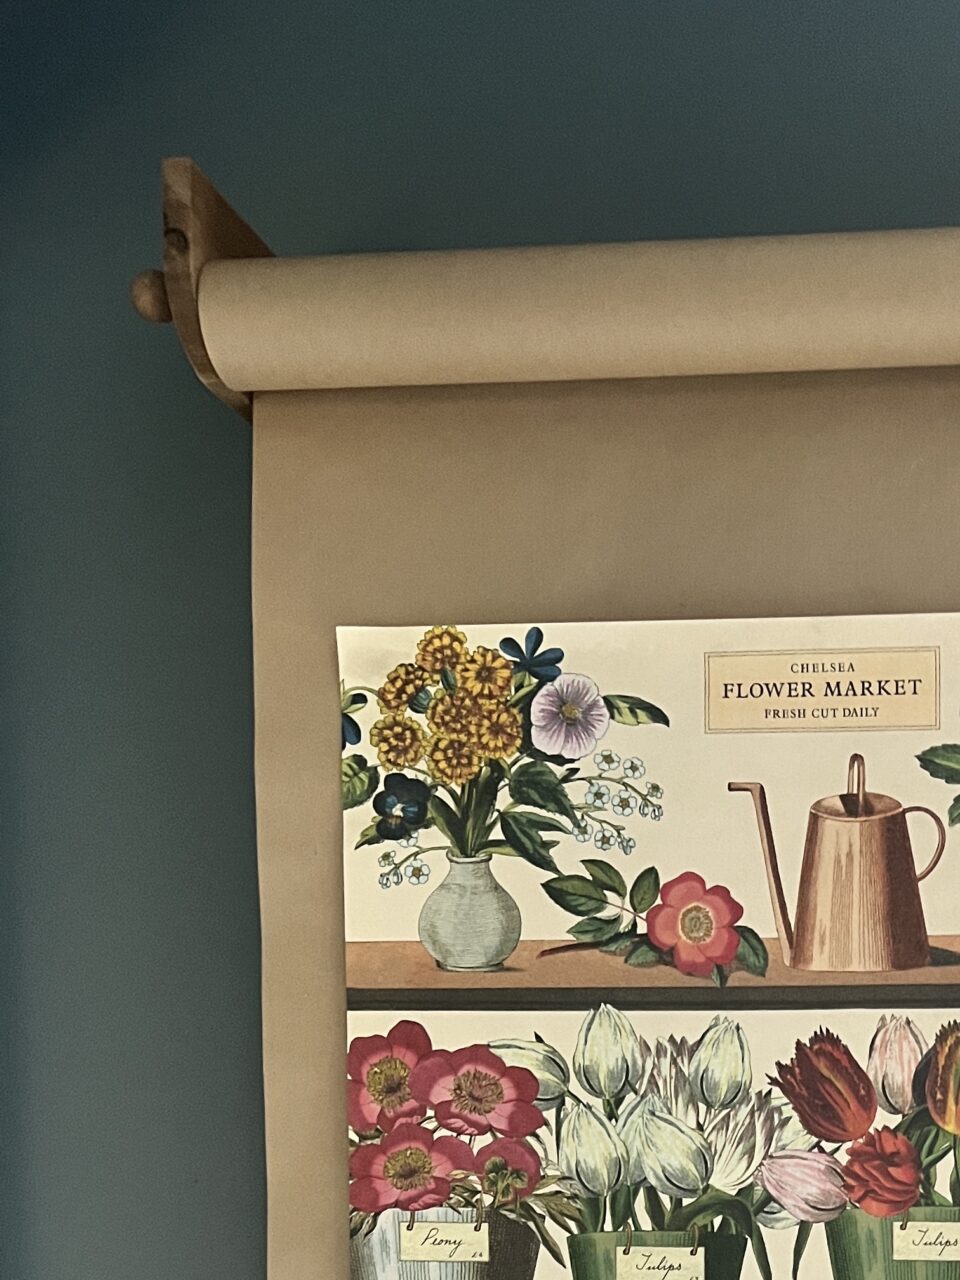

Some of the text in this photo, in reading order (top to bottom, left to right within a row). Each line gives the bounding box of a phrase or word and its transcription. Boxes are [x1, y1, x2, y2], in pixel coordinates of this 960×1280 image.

[790, 662, 856, 674] CHELSEA
[721, 678, 923, 699] FLOWER MARKET
[764, 706, 880, 720] FRESH CUT DAILY
[420, 1227, 464, 1259] Peony
[911, 1228, 959, 1257] Tulips
[635, 1253, 682, 1280] Tulips
